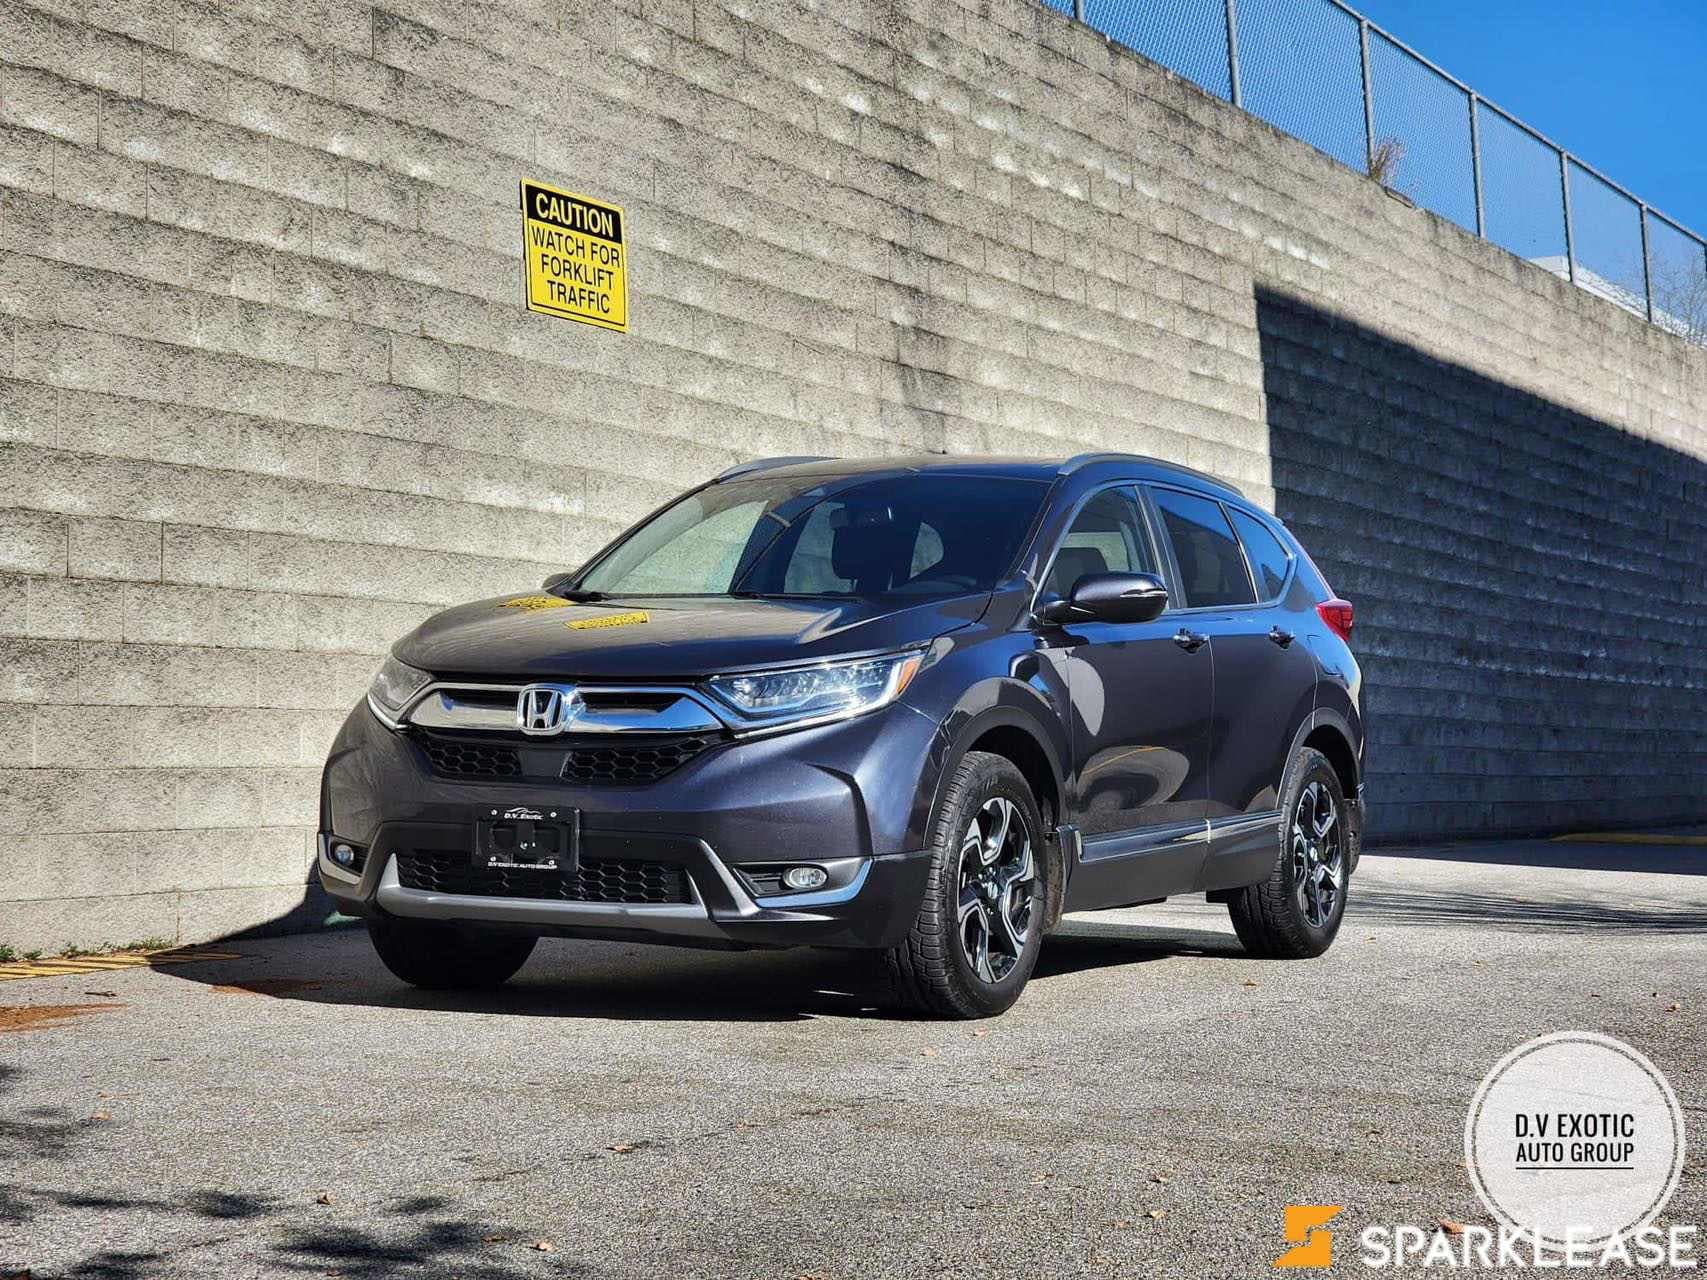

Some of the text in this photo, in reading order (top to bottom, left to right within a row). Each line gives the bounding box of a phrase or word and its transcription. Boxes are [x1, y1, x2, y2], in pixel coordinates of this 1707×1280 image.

[535, 192, 614, 238] CAUTION
[531, 225, 620, 268] WATCH FOR
[541, 253, 614, 290] FORKLIFT
[547, 280, 610, 314] TRAFFIC
